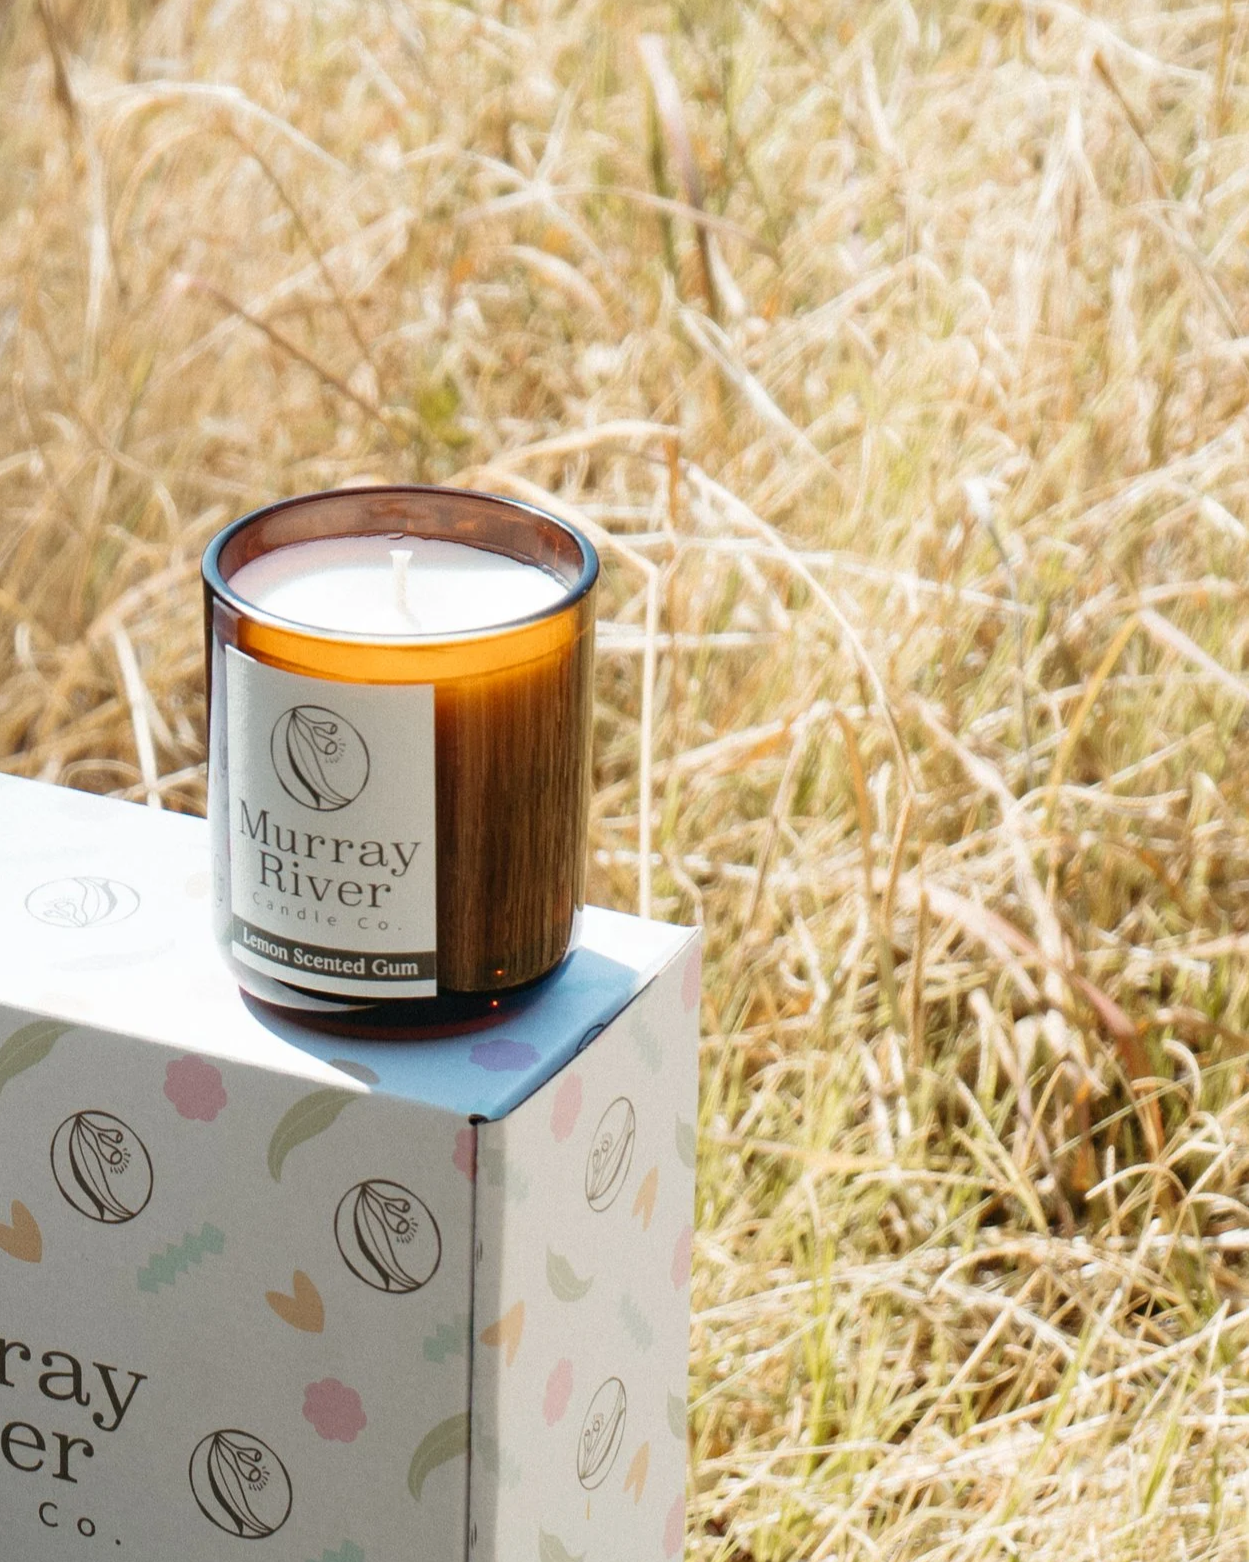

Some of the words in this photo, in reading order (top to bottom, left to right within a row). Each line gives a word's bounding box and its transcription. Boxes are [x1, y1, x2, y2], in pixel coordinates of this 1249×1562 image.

[238, 798, 423, 877] Murray
[258, 849, 392, 909] River
[252, 891, 338, 927] Candle
[357, 916, 404, 932] Co.
[242, 926, 289, 962] Lemon
[293, 949, 365, 976] Scented
[371, 959, 419, 976] Gum
[38, 1501, 122, 1546] Co.
